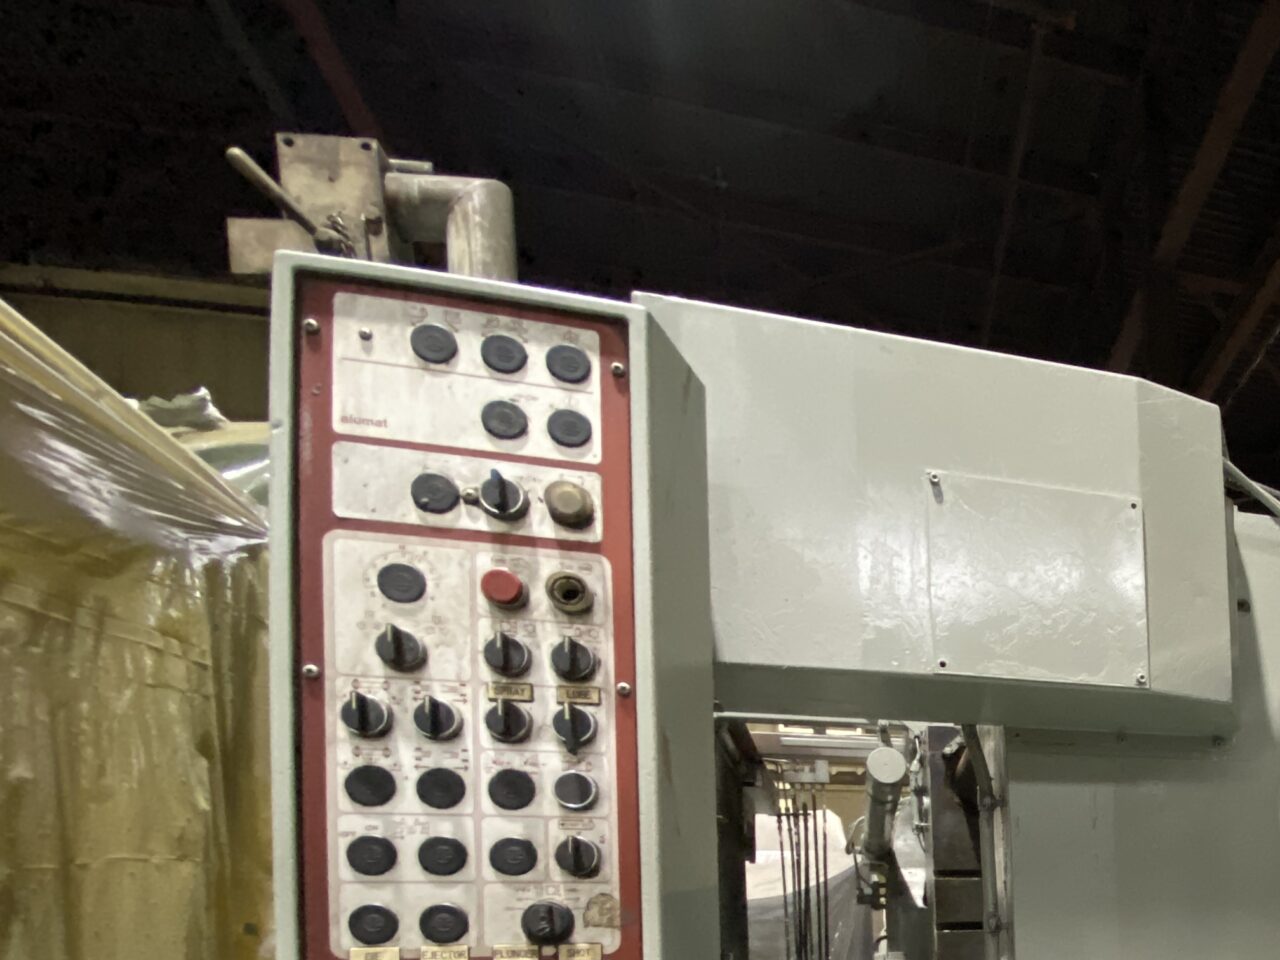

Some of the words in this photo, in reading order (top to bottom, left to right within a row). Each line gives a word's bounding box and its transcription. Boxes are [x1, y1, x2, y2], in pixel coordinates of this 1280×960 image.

[493, 686, 526, 697] SPRAY
[421, 950, 467, 960] EJECTOR
[493, 949, 539, 959] PLUNGER
[566, 949, 590, 958] SHOT
